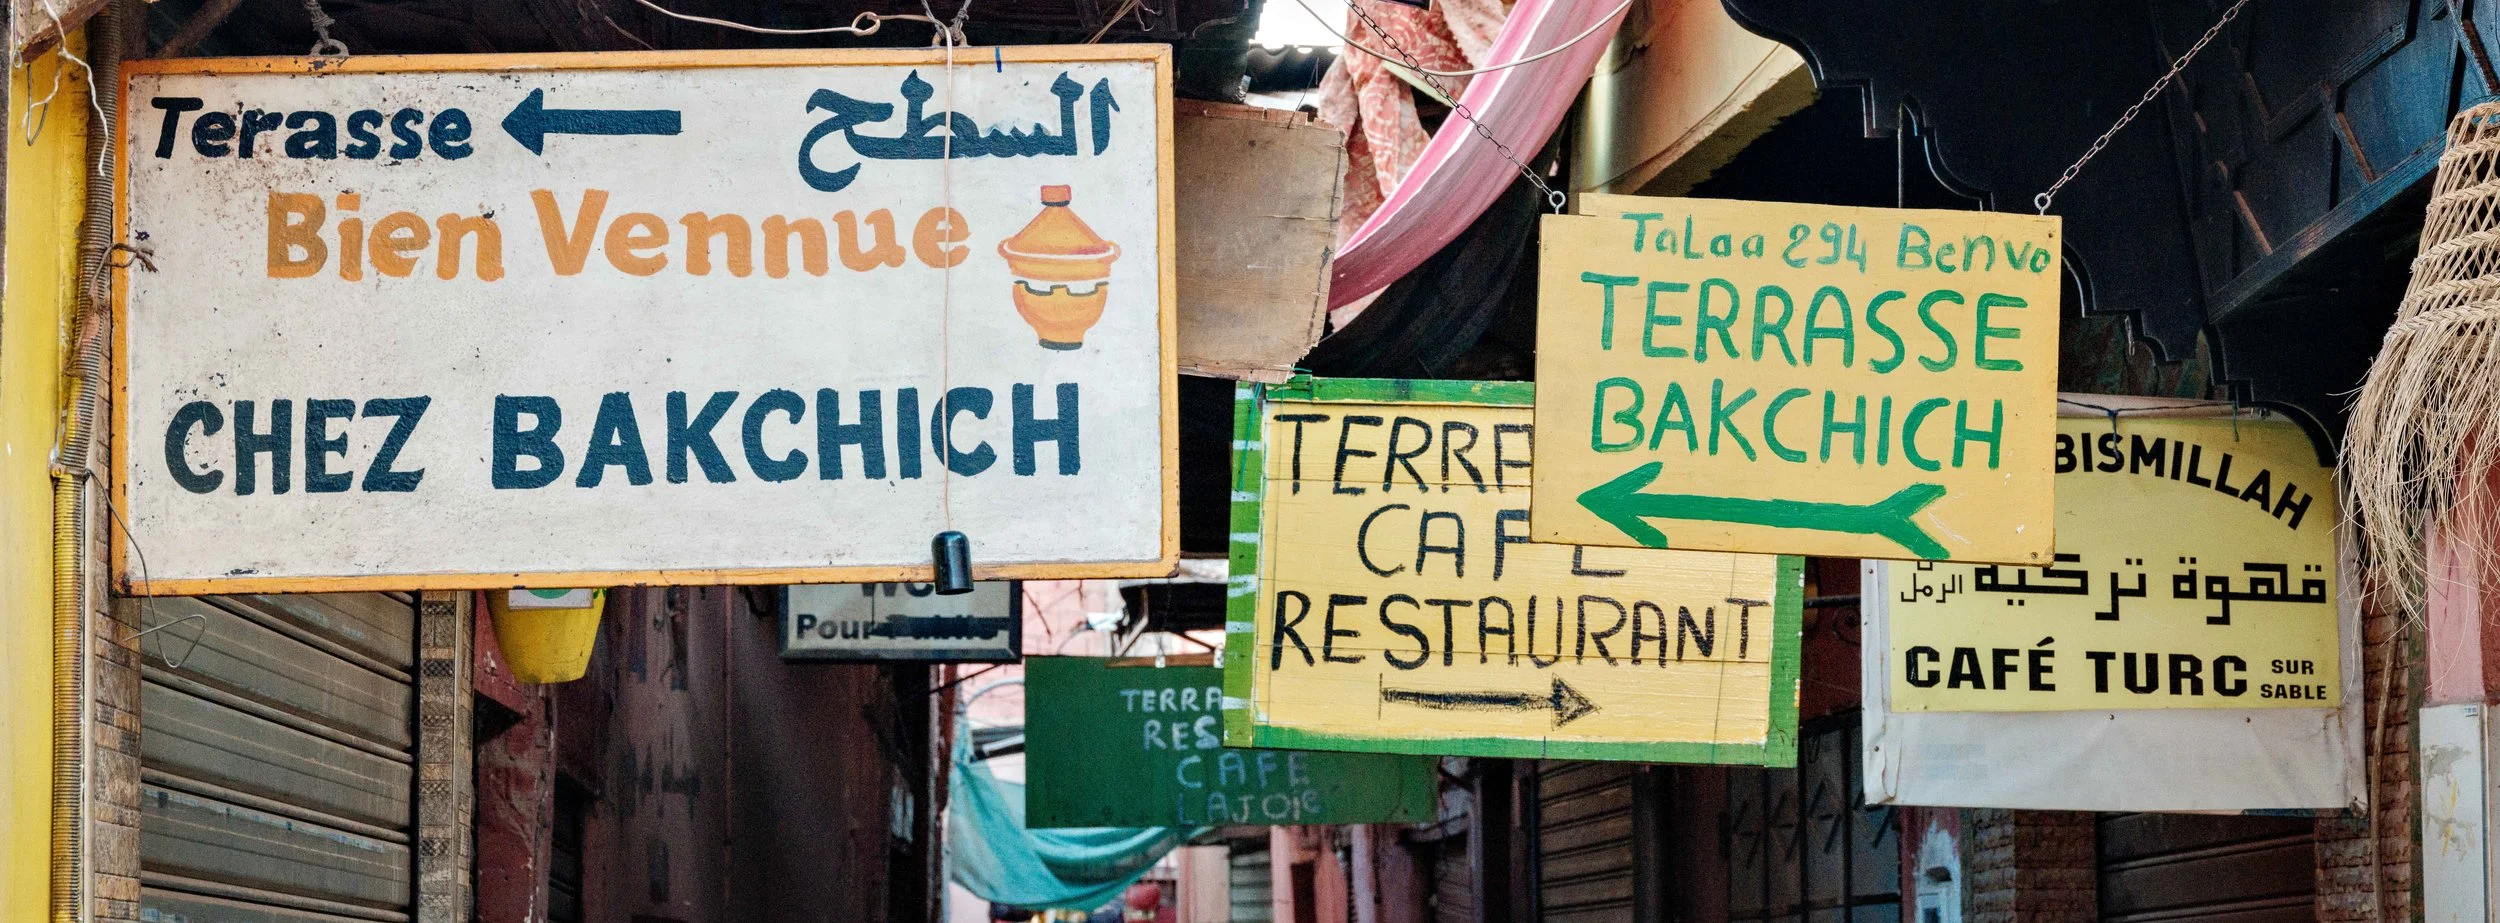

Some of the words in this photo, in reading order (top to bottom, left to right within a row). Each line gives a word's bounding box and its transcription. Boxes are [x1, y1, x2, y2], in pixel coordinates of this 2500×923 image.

[150, 96, 474, 161] Terasse
[798, 69, 1121, 193] السطح
[267, 190, 505, 283] Bien
[530, 188, 971, 279] Vennue
[1580, 271, 2028, 374] TERRASSE
[164, 395, 432, 496] CHEZ
[491, 382, 1081, 490] BAKCHICH
[1590, 377, 2004, 471] BAKCHICH
[2054, 431, 2314, 531] BISMILLAH
[1271, 590, 1770, 670] RESTAURANT
[2172, 556, 2328, 626] قهوة
[1905, 636, 2056, 692] CAFÉ
[2085, 650, 2248, 697] TURC
[2270, 658, 2315, 676] SUR
[2260, 682, 2328, 701] SABLE
[1176, 750, 1311, 789] CAFE
